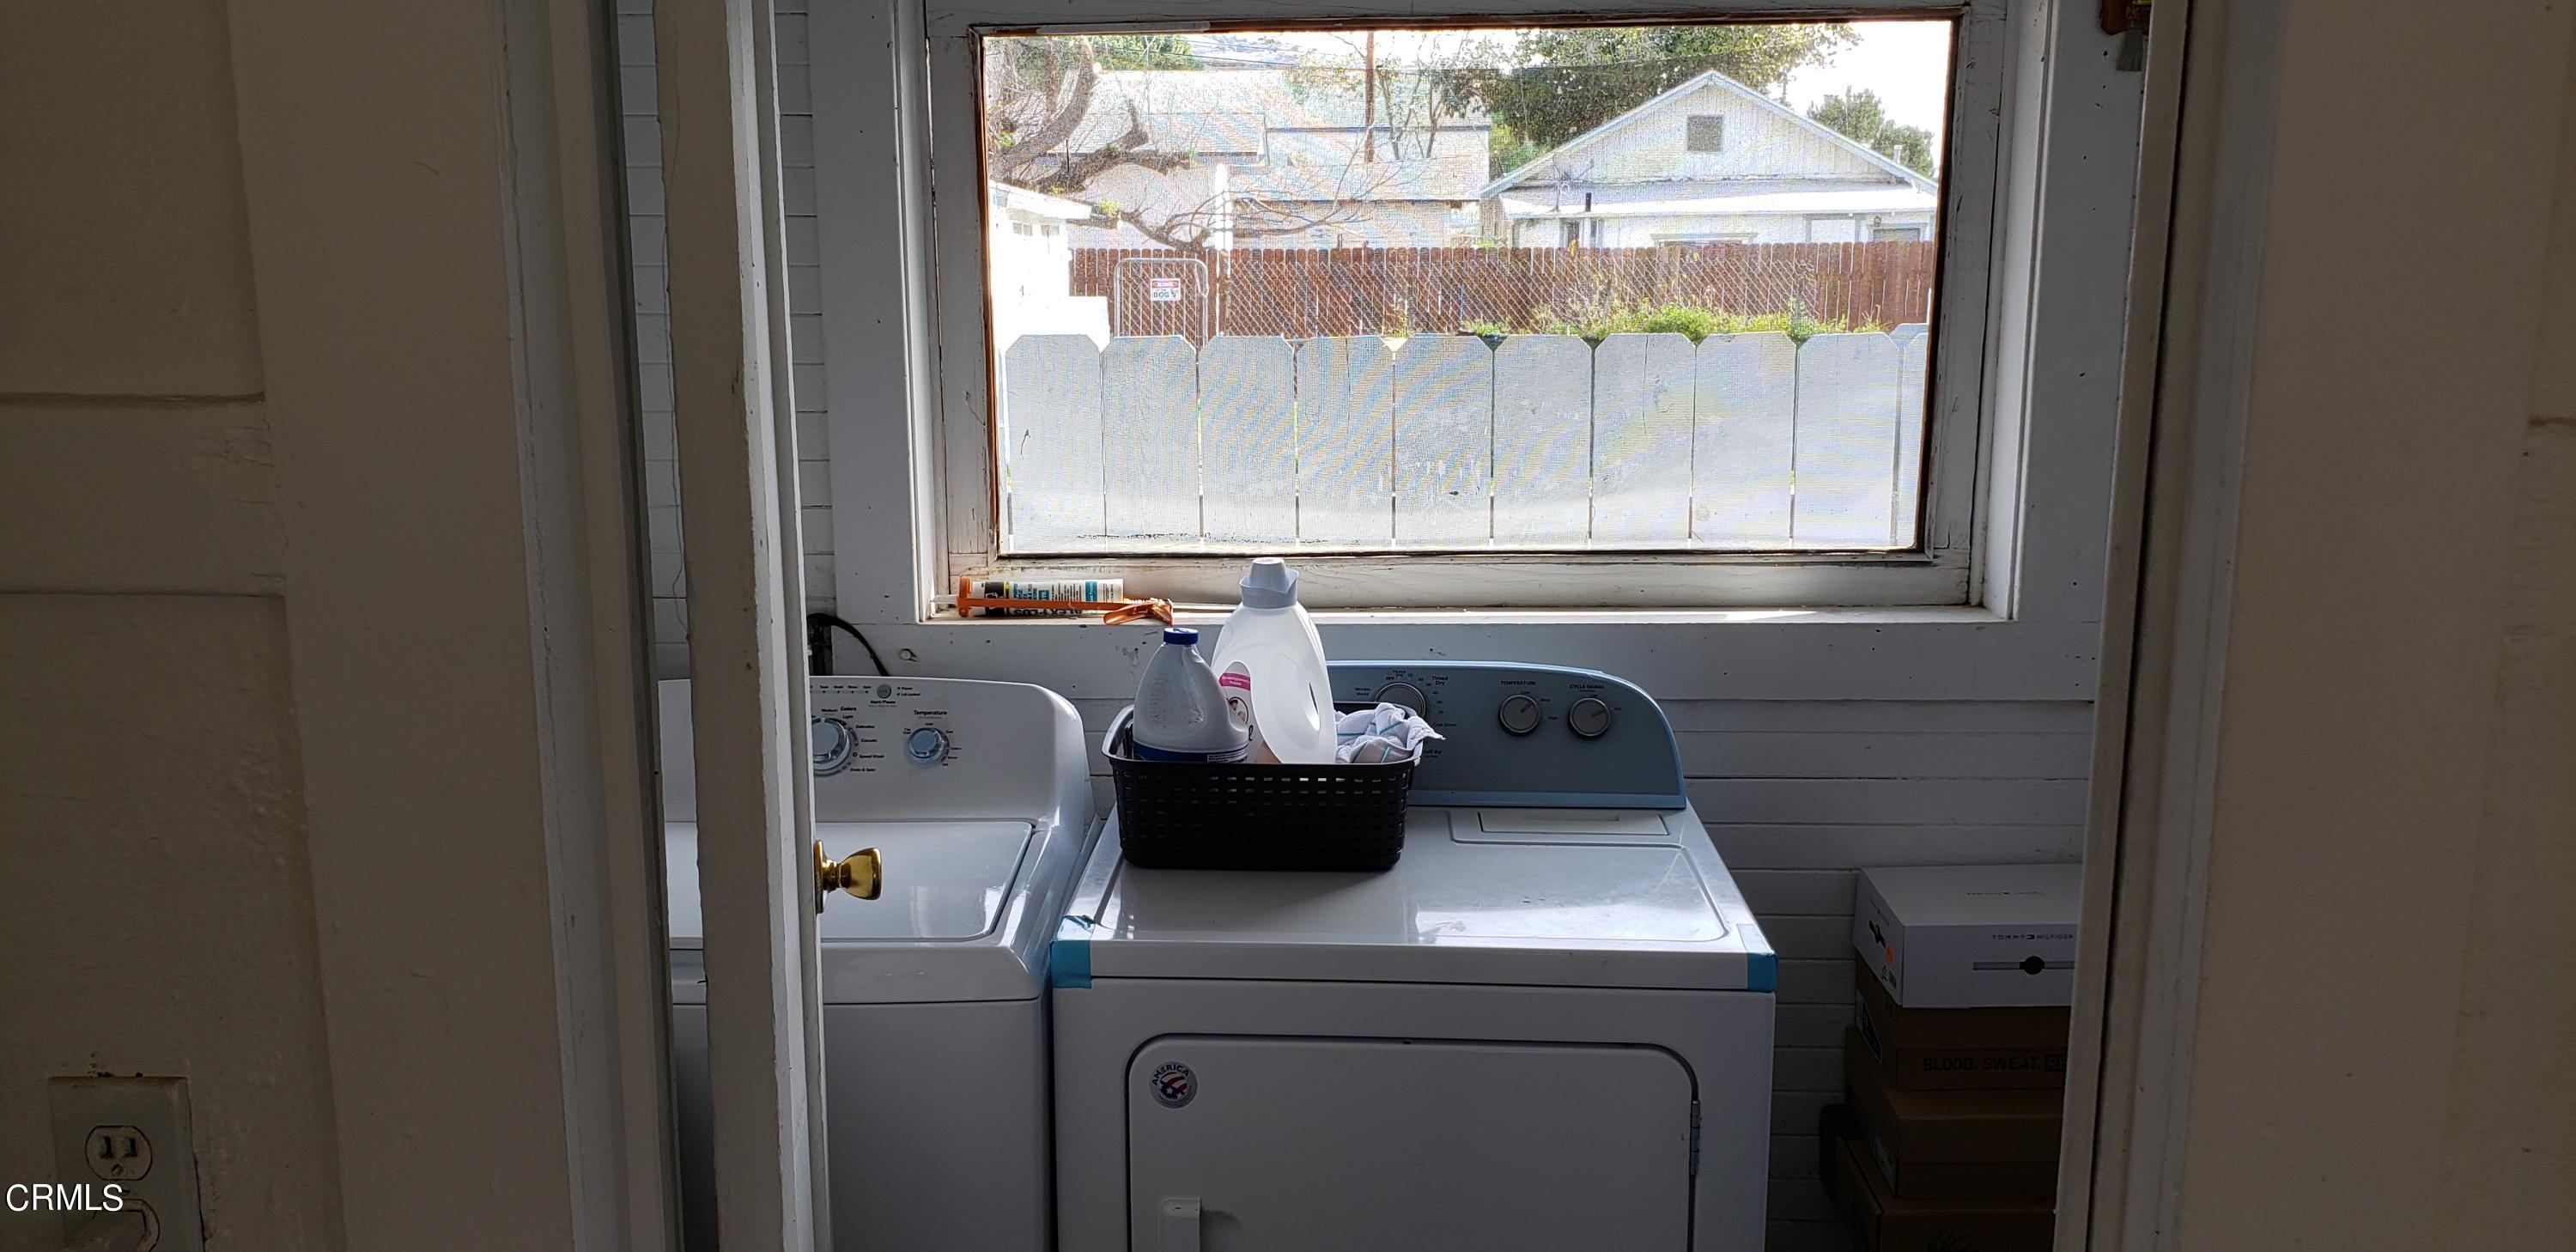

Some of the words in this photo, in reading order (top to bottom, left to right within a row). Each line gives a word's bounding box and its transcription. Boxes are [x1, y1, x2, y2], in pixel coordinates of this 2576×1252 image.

[1923, 1057, 1978, 1071] BLOOD.
[1982, 1055, 2040, 1071] SWEAT.
[1151, 1064, 1189, 1086] AMERICA
